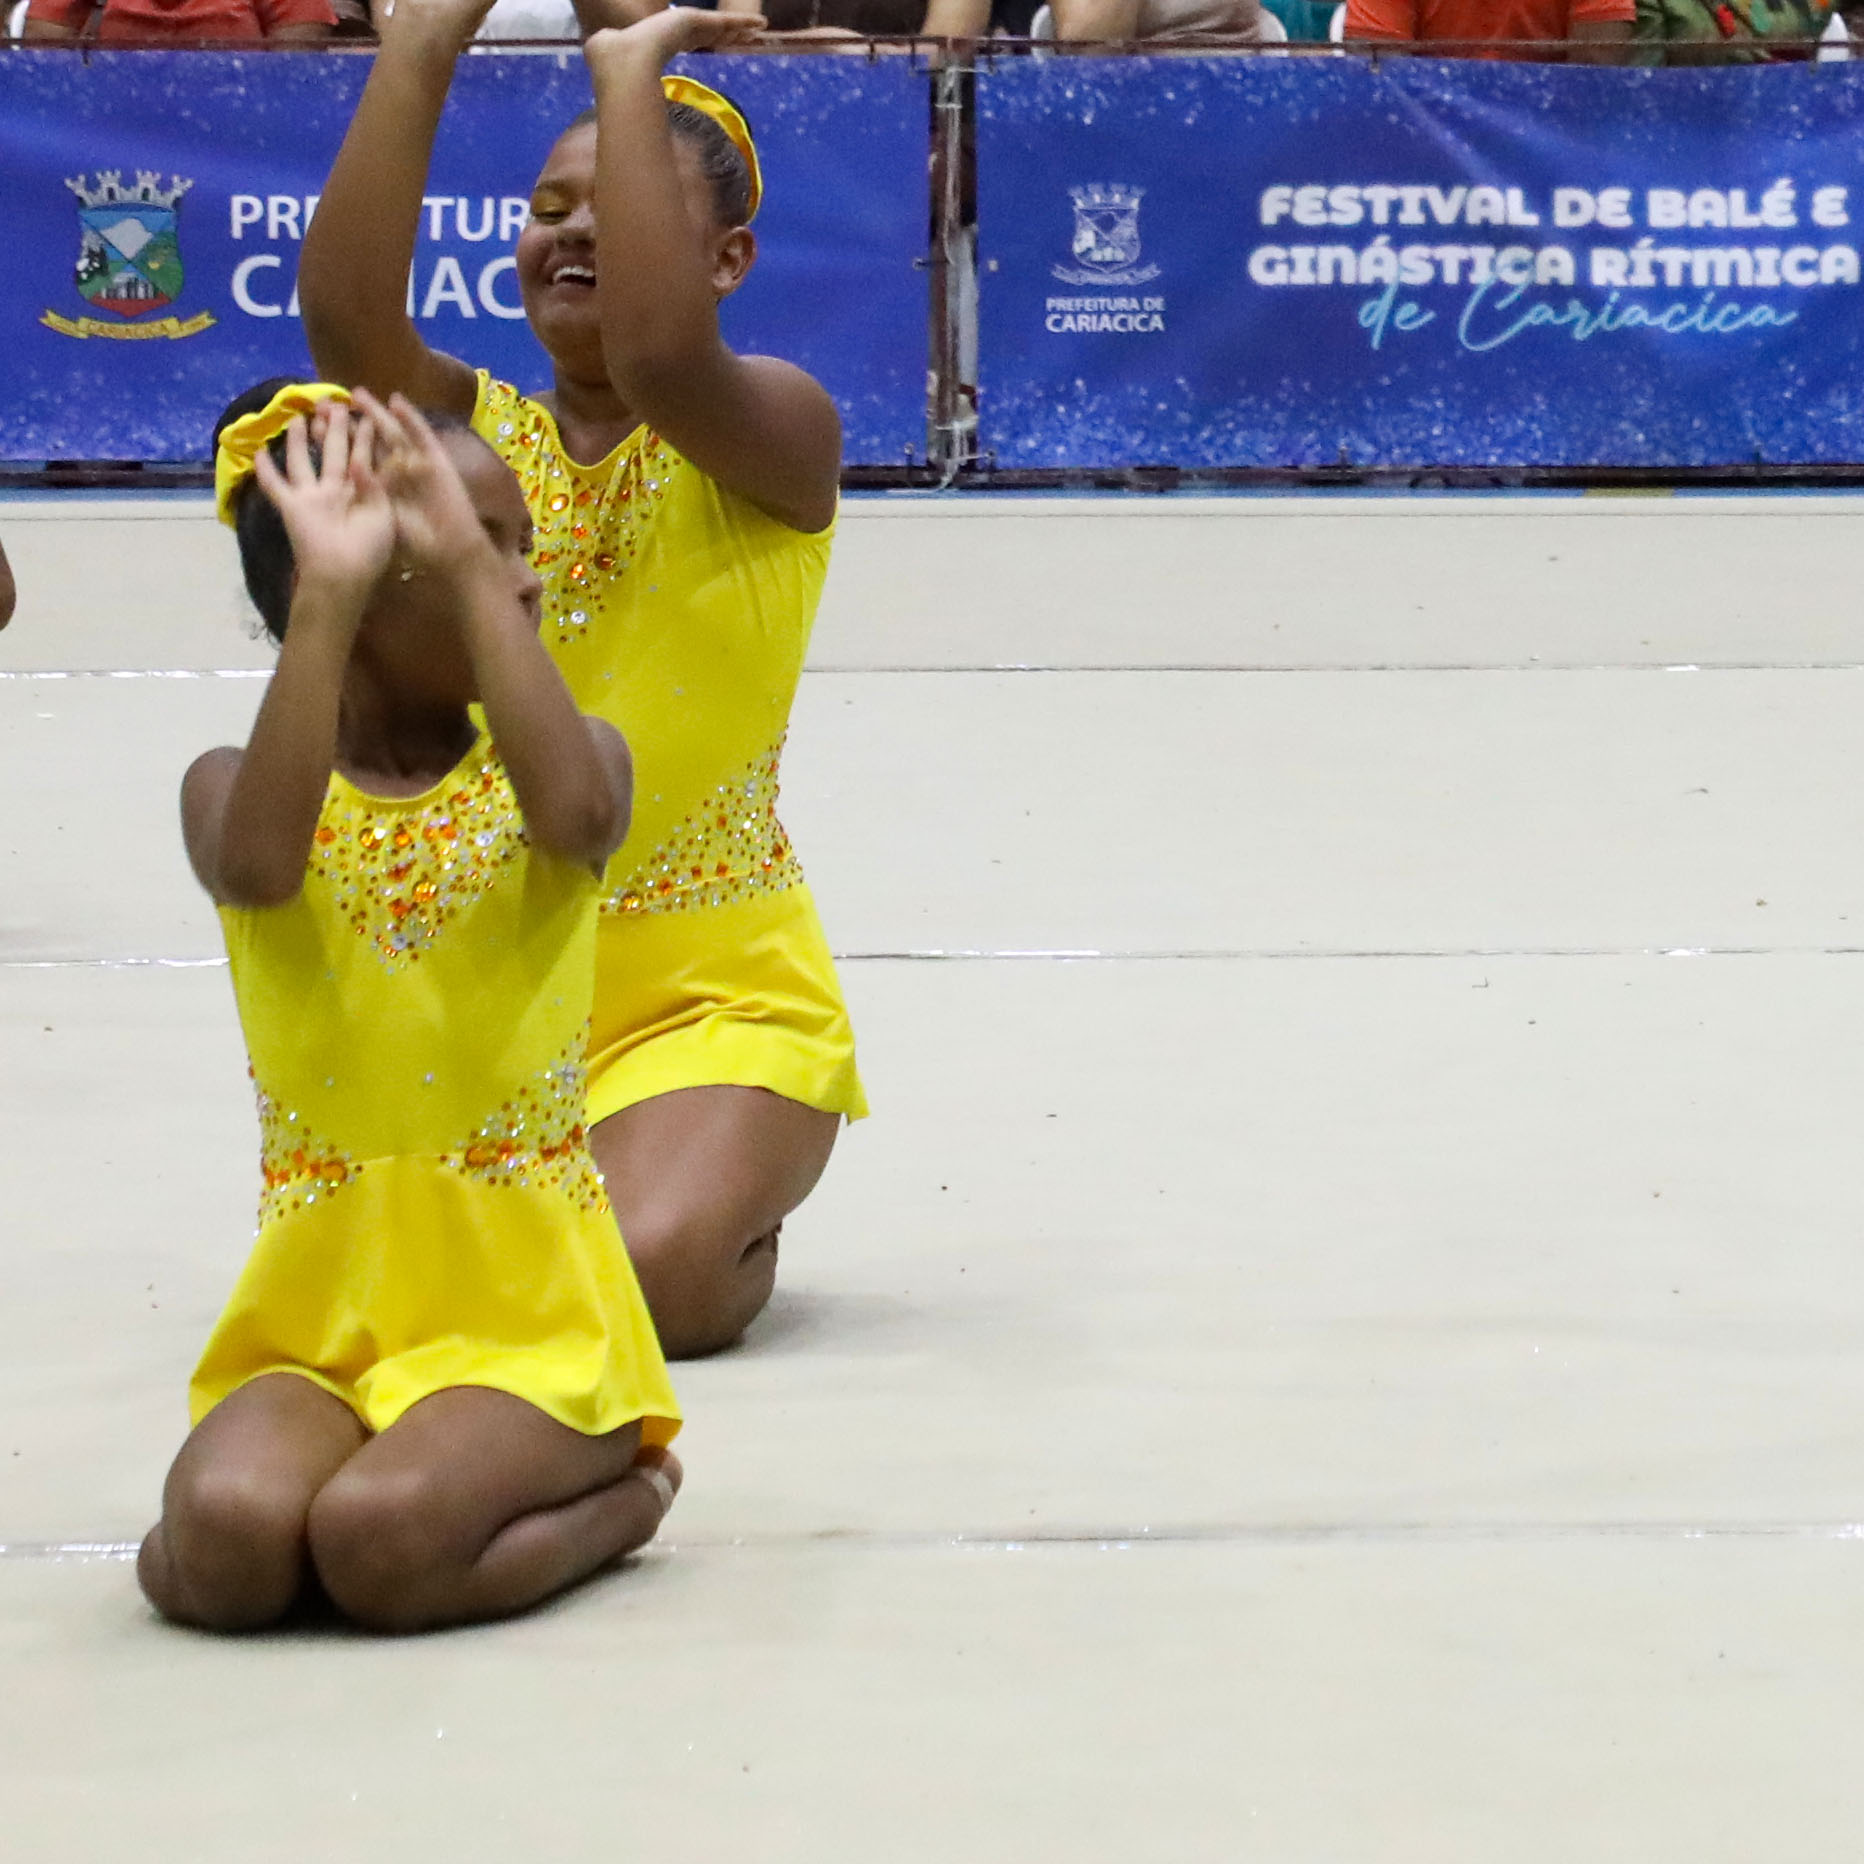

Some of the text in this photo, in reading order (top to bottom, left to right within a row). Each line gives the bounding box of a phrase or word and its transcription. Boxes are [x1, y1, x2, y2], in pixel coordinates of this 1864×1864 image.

[1260, 178, 1849, 228] FESTIVAL DE BALÉ E
[1248, 235, 1859, 287] GINÁSTICA RÍTMICA
[1045, 314, 1165, 333] CARIACICA
[1046, 297, 1165, 312] PREFEITURA DE
[1358, 266, 1797, 352] de Cariacica
